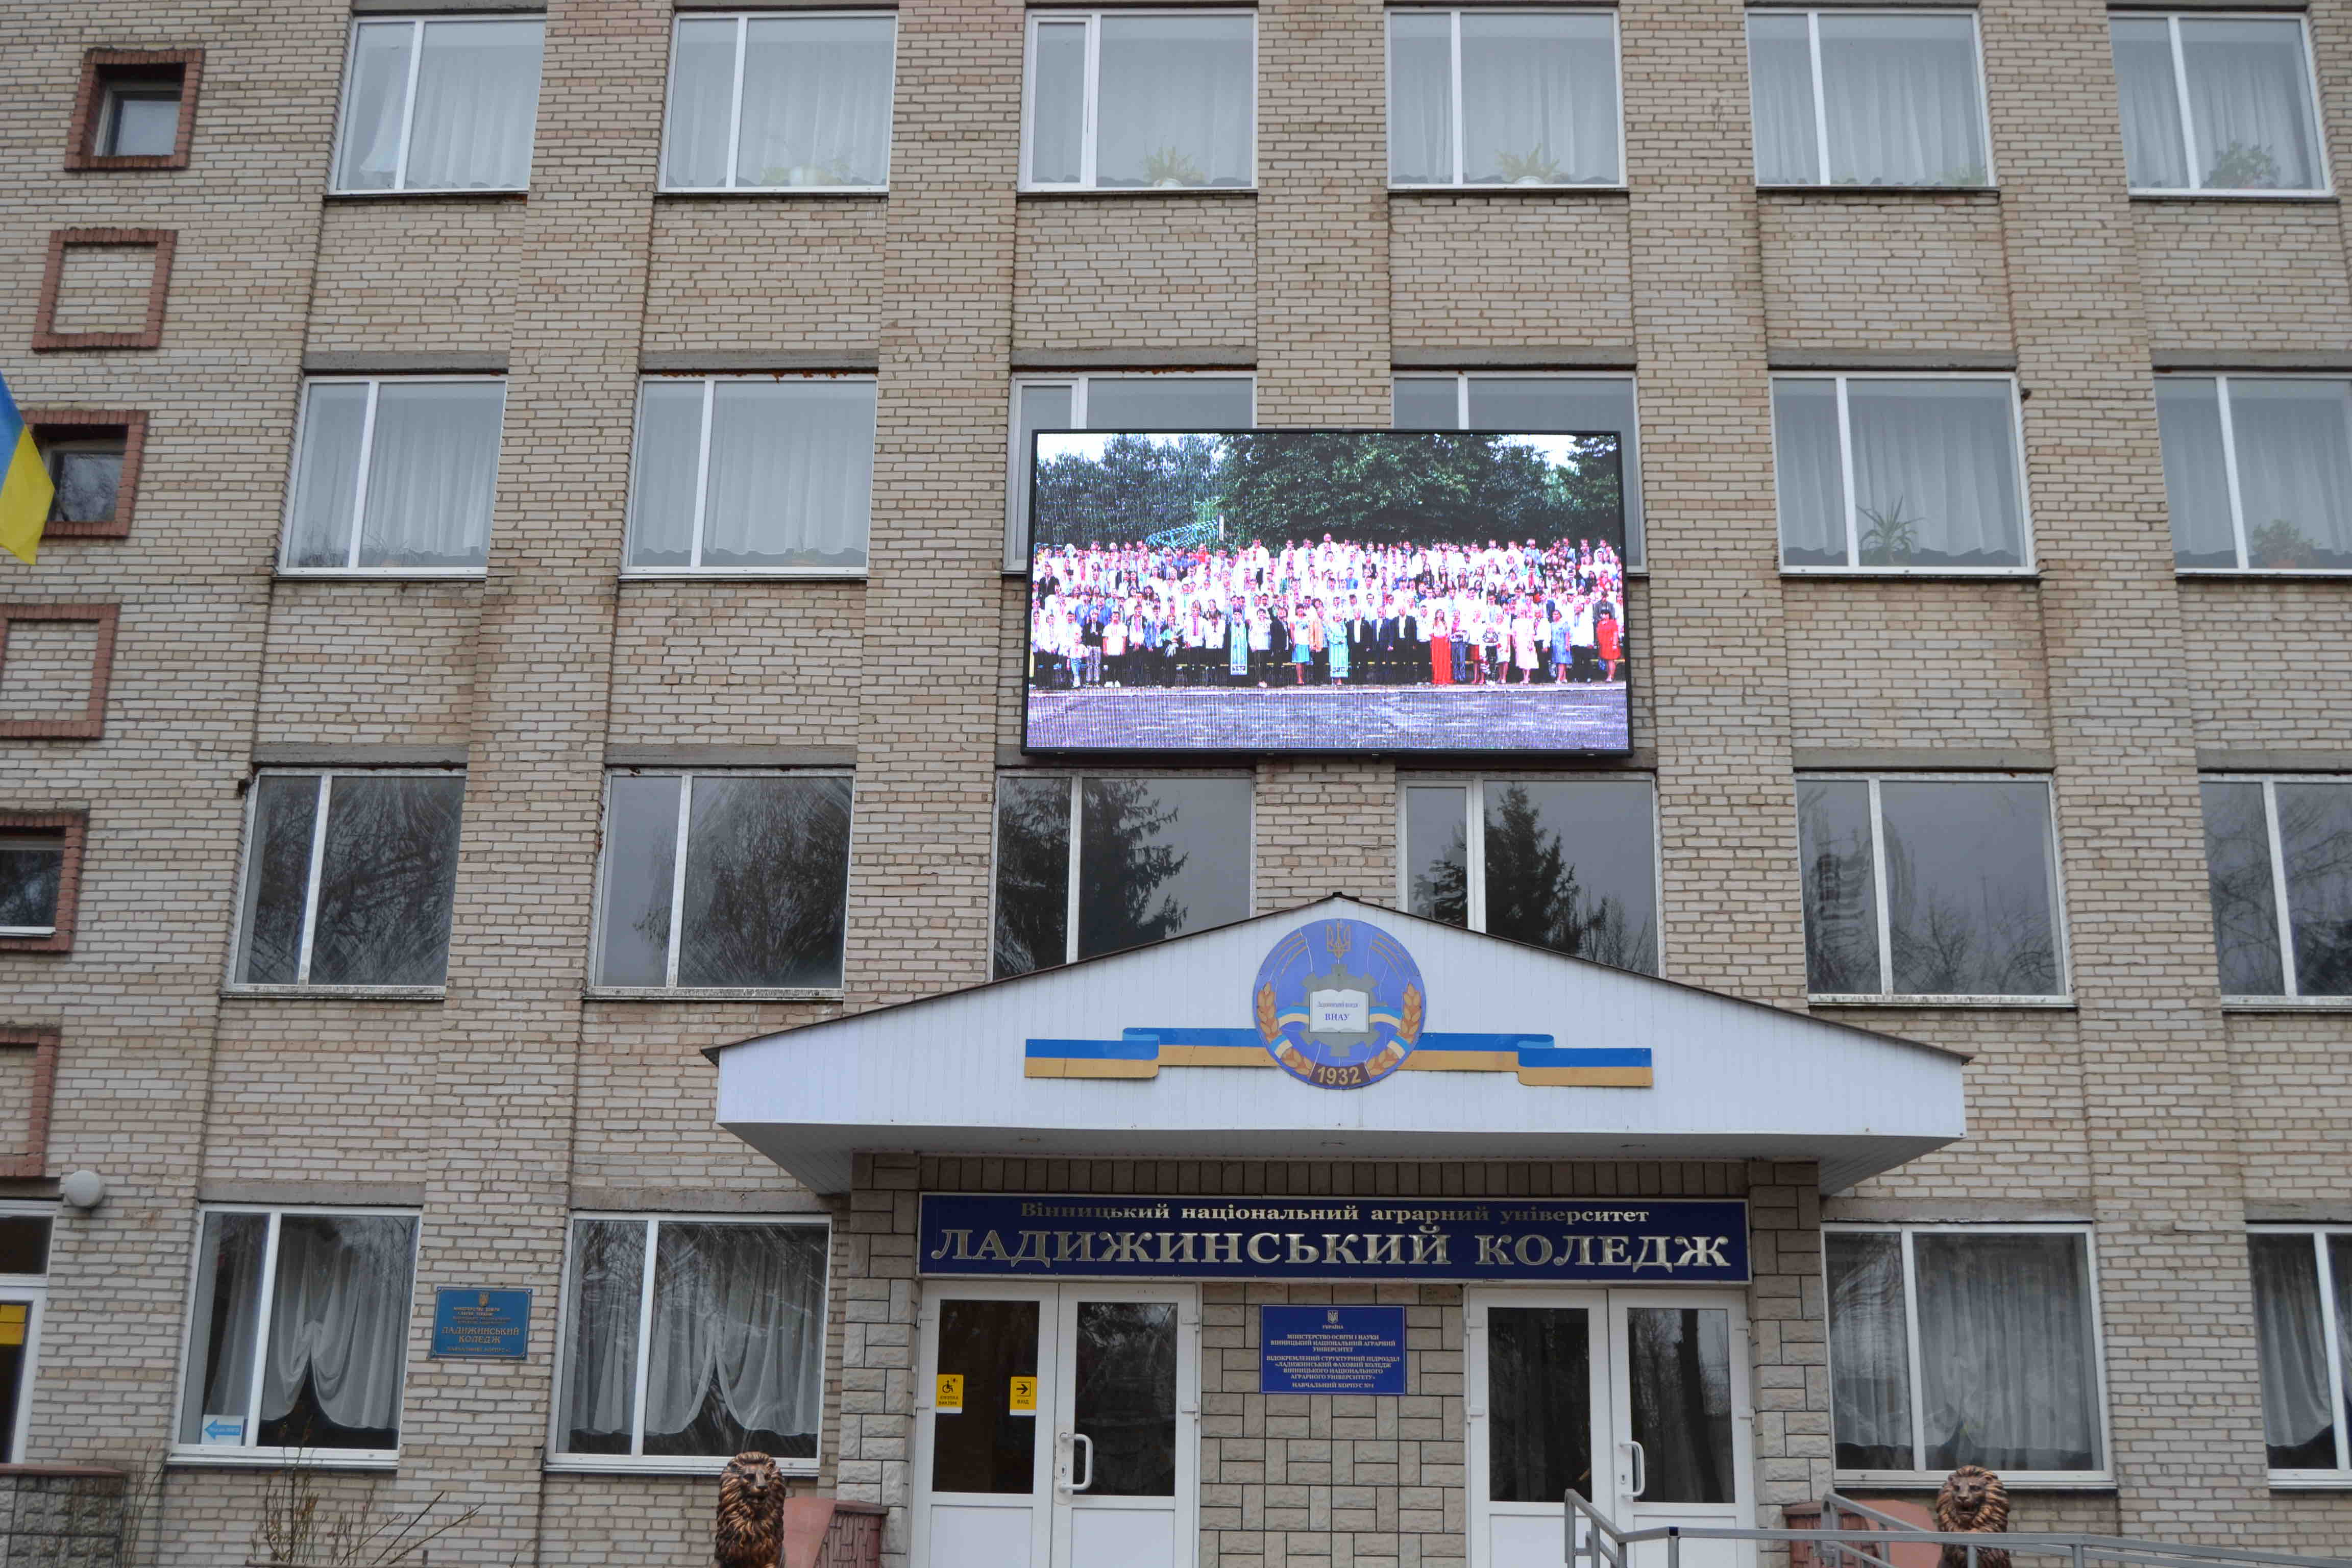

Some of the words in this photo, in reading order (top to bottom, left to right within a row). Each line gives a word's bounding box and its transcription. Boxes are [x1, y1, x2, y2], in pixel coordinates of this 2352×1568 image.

[1318, 1066, 1361, 1085] 1932
[1021, 1203, 1169, 1219] Вінницький
[1181, 1205, 1360, 1220] національний
[1371, 1206, 1489, 1224] аграрний
[1500, 1206, 1650, 1225] університет
[931, 1225, 1451, 1268] ЛАДИЖИНСЬКИЙ
[1475, 1234, 1731, 1273] КОЛЕДЖ
[441, 1327, 519, 1336] ЛАДИЖИНСЬКИЙ
